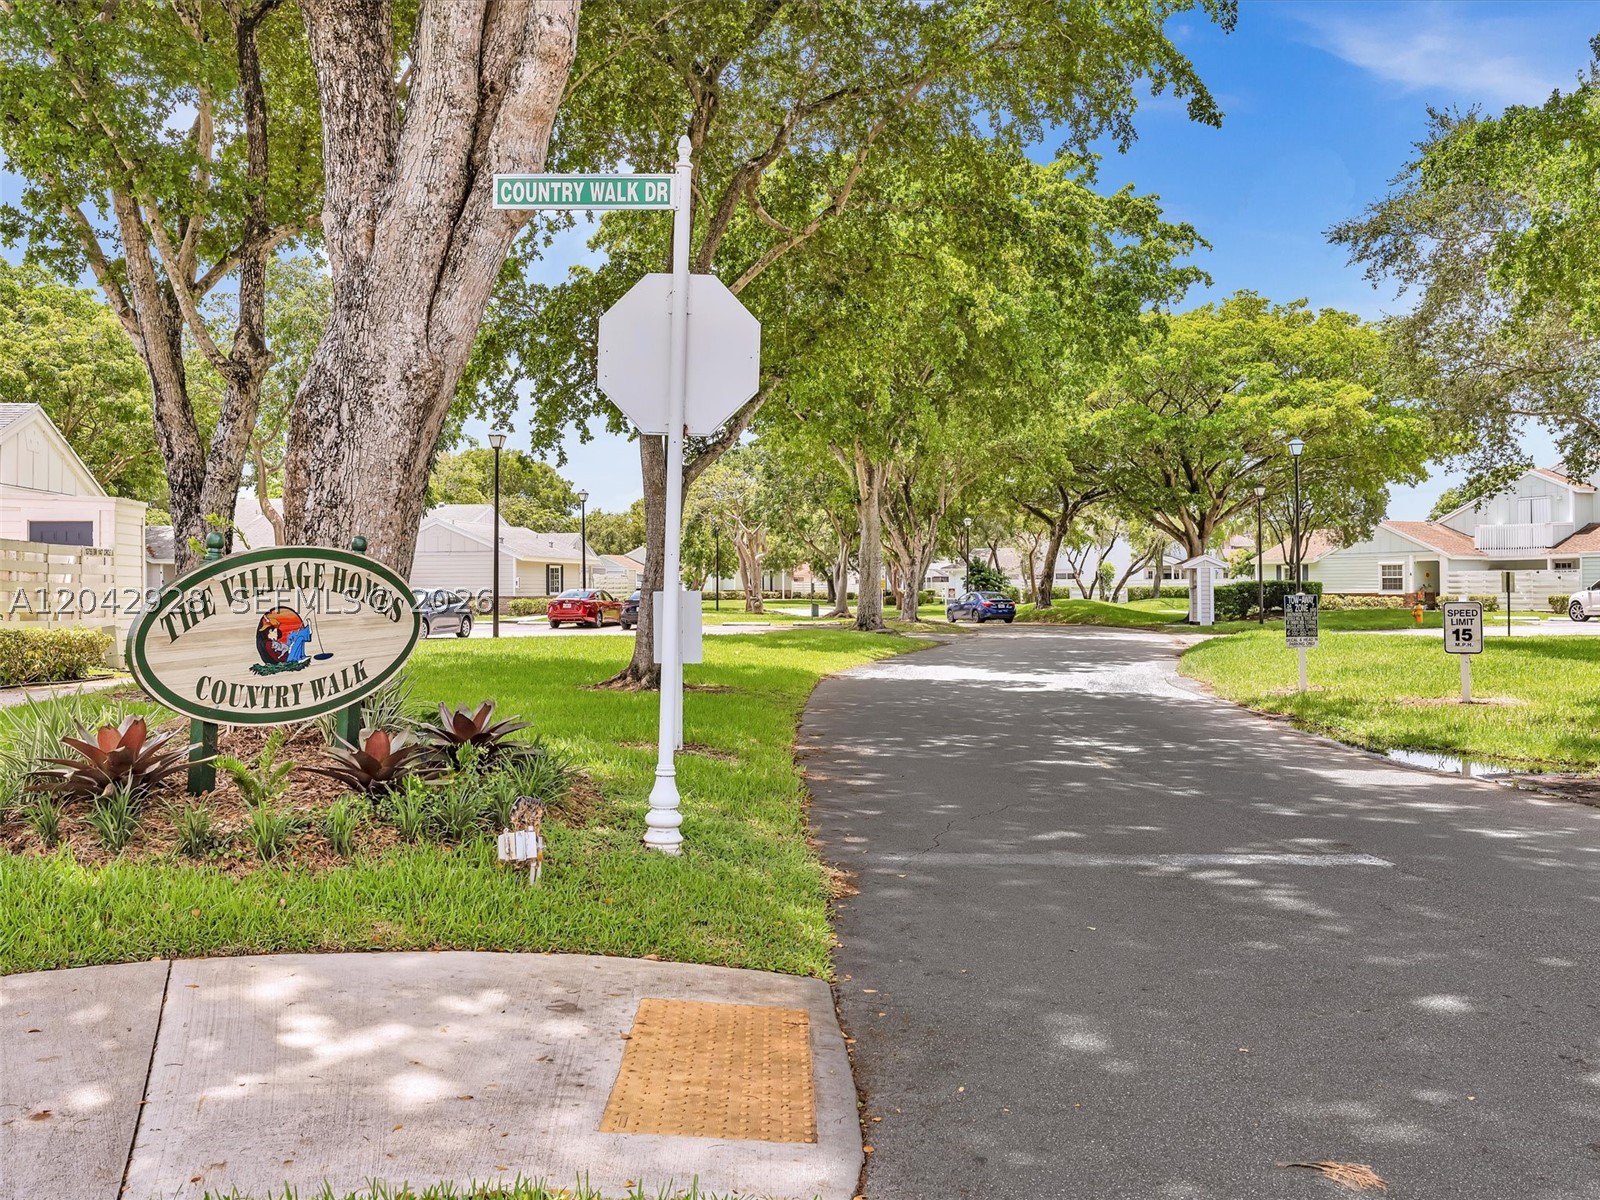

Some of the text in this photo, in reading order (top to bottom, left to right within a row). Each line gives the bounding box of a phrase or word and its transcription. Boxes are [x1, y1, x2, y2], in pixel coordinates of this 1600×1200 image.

[500, 181, 668, 202] COUNTRY WALK DR
[160, 560, 405, 644] THE VILLAGE HOMES
[1294, 603, 1309, 612] ZONE
[1447, 609, 1478, 617] SPEED
[1452, 628, 1473, 641] 15
[195, 659, 369, 709] COUNTRY WALK
